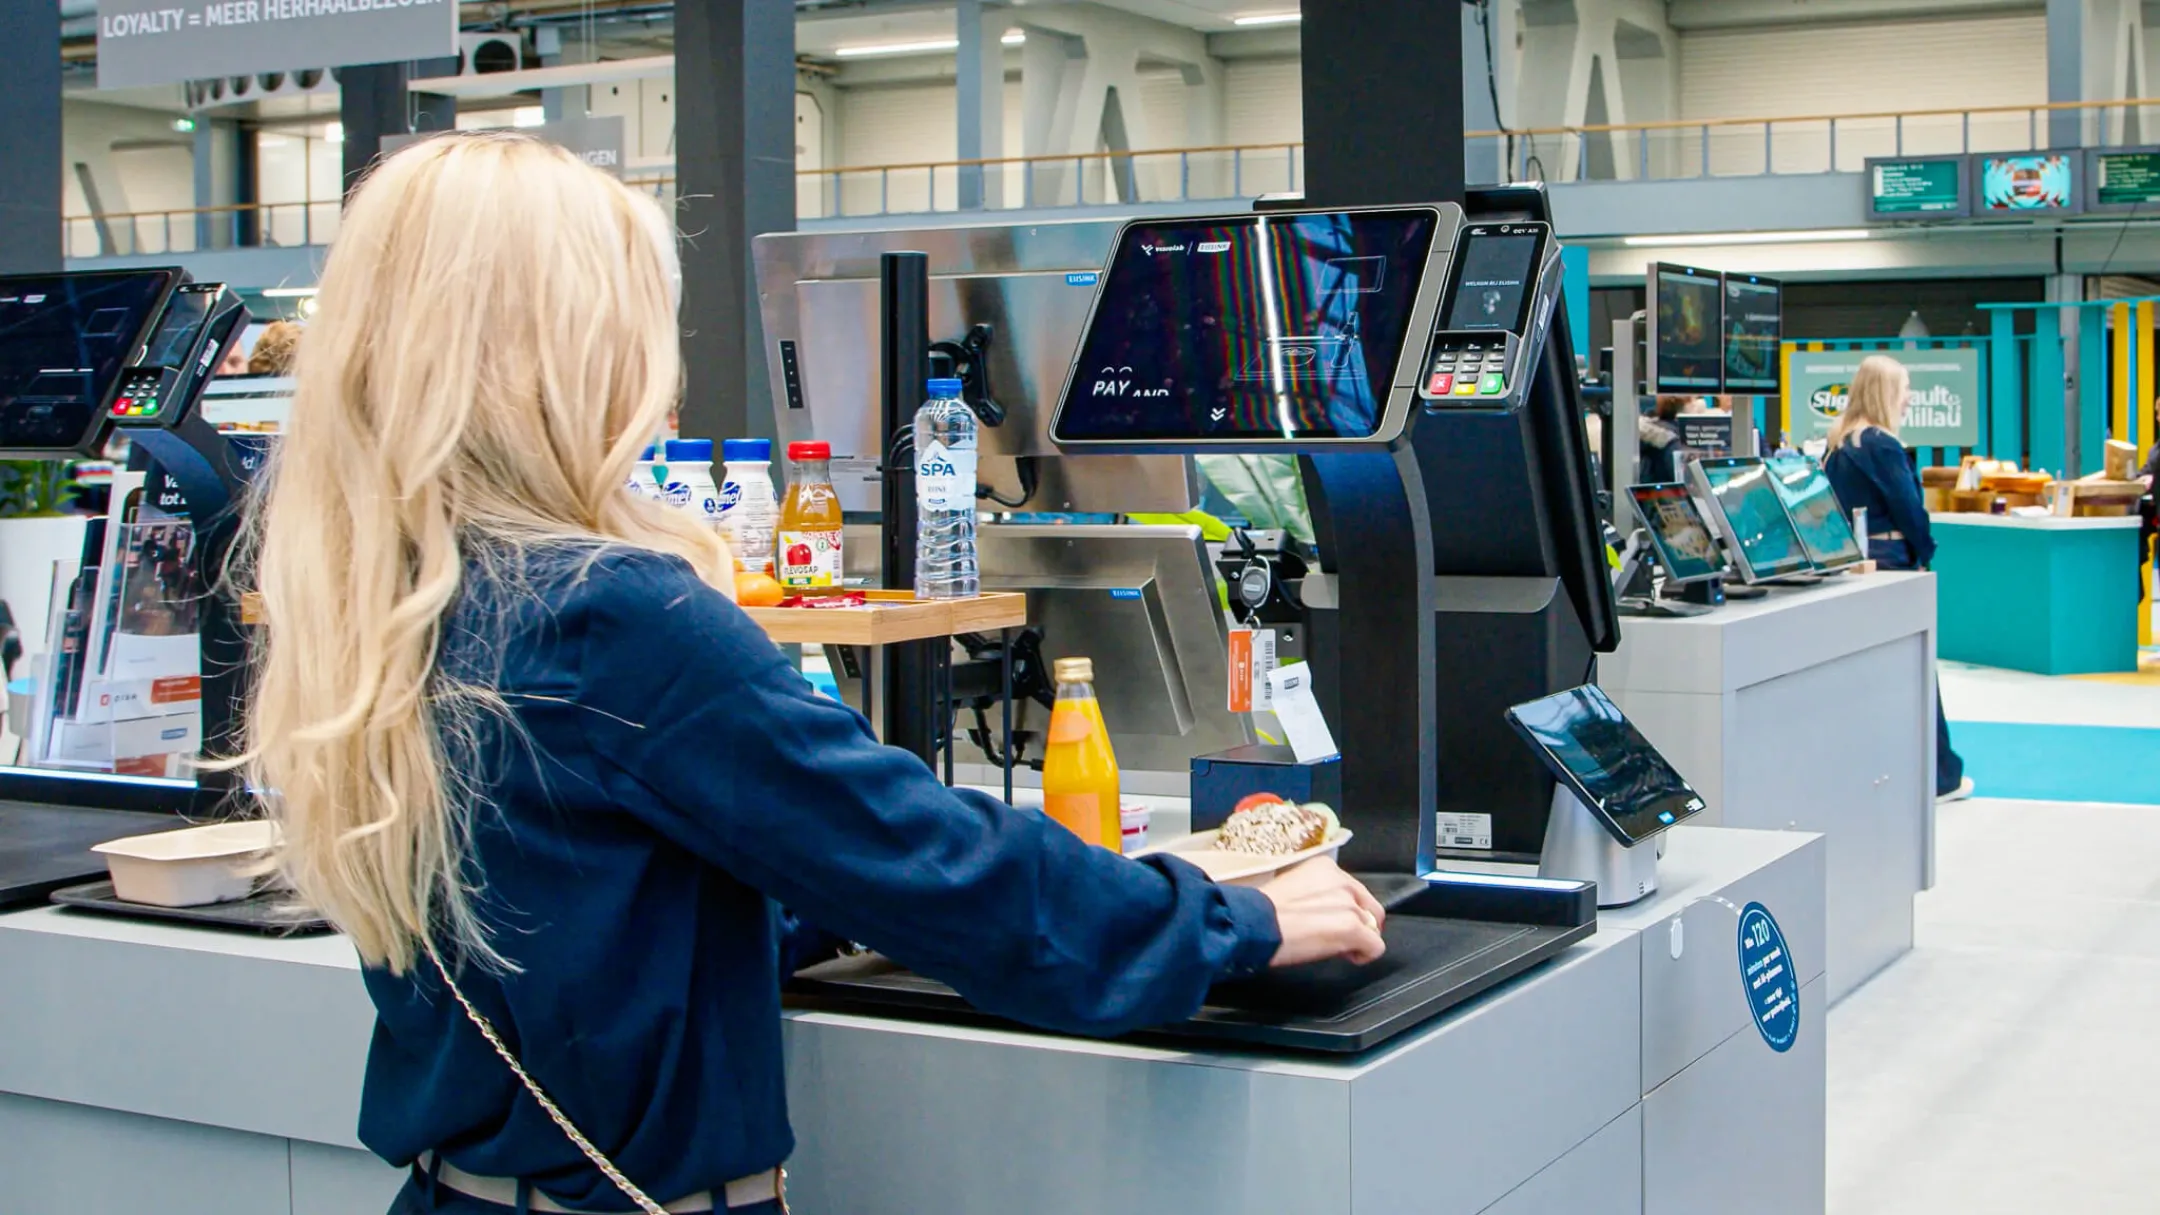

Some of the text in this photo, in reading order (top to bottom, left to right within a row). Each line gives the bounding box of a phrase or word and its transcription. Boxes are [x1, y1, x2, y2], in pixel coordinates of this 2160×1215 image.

[103, 0, 441, 38] LOYALTY = MEER HERHAALB
[1092, 380, 1131, 396] PAY
[1812, 387, 1850, 410] Slig
[920, 463, 957, 477] SPA
[160, 492, 180, 505] tot
[1751, 919, 1770, 947] 120
